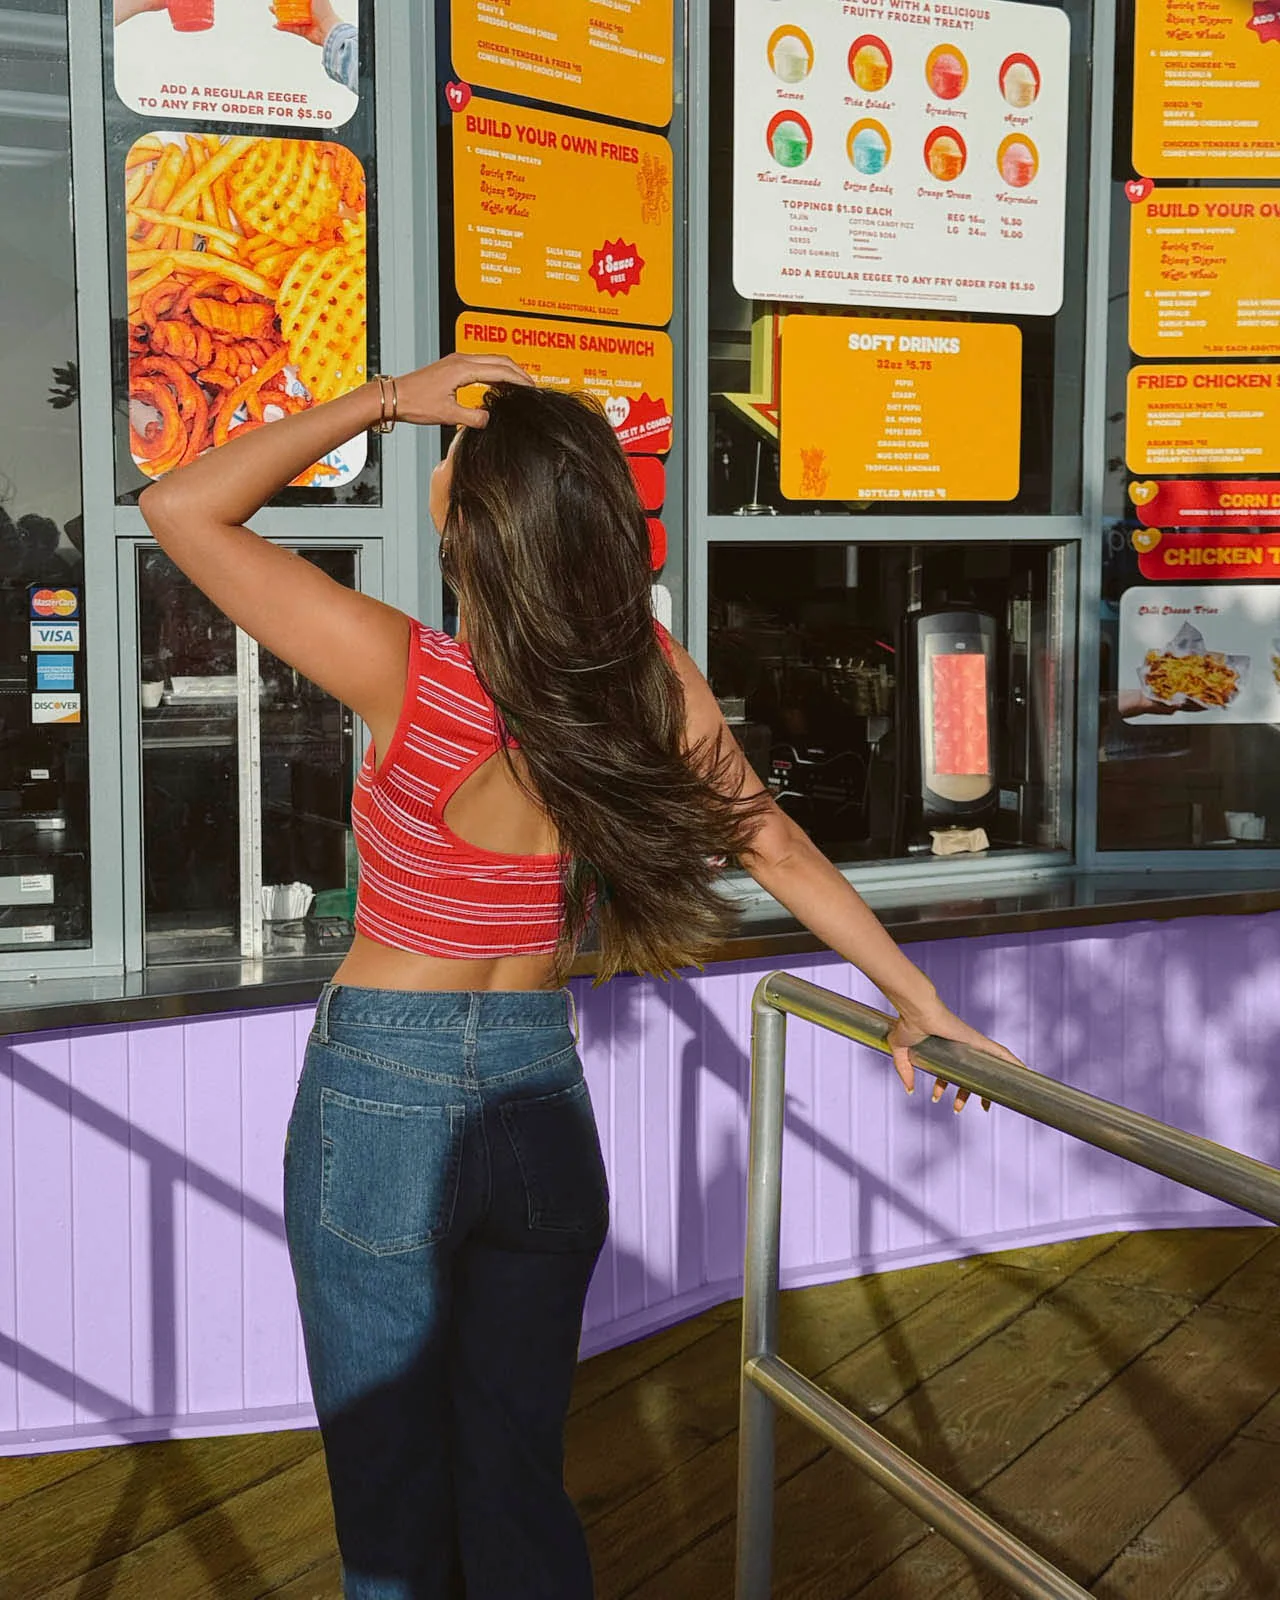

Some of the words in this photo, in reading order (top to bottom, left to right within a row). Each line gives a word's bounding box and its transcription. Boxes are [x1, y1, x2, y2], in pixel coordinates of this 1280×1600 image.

[890, 0, 920, 11] WITH
[923, 3, 931, 13] A
[934, 4, 991, 20] DELICIOUS
[842, 5, 883, 19] FRUITY
[887, 11, 931, 25] FROZEN
[934, 17, 974, 31] TREAT!
[160, 84, 187, 95] ADD
[191, 86, 200, 96] A
[204, 87, 264, 101] REGULAR
[267, 92, 308, 104] EEGEE
[450, 88, 462, 104] $7
[138, 97, 157, 107] TO
[162, 99, 188, 110] ANY
[193, 101, 218, 112] FRY
[222, 103, 264, 116] ORDER
[268, 106, 293, 118] FOR
[297, 107, 332, 120] $5.50
[466, 115, 512, 140] BUILD
[515, 125, 557, 149] YOUR
[561, 134, 597, 156] OWN
[601, 142, 639, 164] FRIES
[1130, 184, 1144, 196] $7
[782, 200, 833, 212] TOPPINGS
[836, 203, 863, 214] $1.50
[866, 207, 893, 216] EACH
[1147, 204, 1200, 218] BUILD
[1205, 204, 1255, 217] YOUR
[947, 213, 965, 222] REG
[947, 226, 959, 234] LG
[598, 260, 605, 276] 1
[604, 254, 635, 273] Sauce
[610, 273, 626, 284] FREE
[781, 267, 801, 277] ADD
[804, 269, 812, 278] A
[814, 269, 859, 281] REGULAR
[862, 272, 892, 283] EEGEE
[896, 275, 909, 284] TO
[912, 275, 932, 285] ANY
[934, 277, 953, 286] FRY
[955, 278, 986, 288] ORDER
[989, 280, 1007, 290] FOR
[1010, 281, 1035, 291] $5.50
[519, 297, 537, 306] $1.50
[538, 300, 556, 308] EACH
[557, 301, 597, 313] ADDITIONAL
[598, 307, 620, 315] SAUCE
[464, 323, 507, 343] FRIED
[511, 328, 576, 350] CHICKEN
[579, 335, 655, 357] SANDWICH
[848, 333, 896, 352] SOFT
[898, 335, 960, 354] DRINKS
[877, 360, 903, 369] 32oz
[906, 360, 932, 371] $5.75
[895, 379, 914, 387] PEPSI
[1137, 375, 1188, 389] FRIED
[1193, 374, 1272, 388] CHICKEN
[616, 429, 630, 440] AKE
[630, 426, 638, 437] IT
[639, 424, 646, 434] A
[646, 416, 672, 430] COMBO
[858, 489, 900, 498] BOTTLED
[902, 489, 935, 498] WATER
[1219, 494, 1268, 507] CORN
[1163, 547, 1263, 566] CHICKEN
[33, 598, 77, 608] MasterCard
[1138, 605, 1160, 616] Chili
[1161, 605, 1192, 616] Cheese
[1193, 605, 1219, 615] Fries
[39, 630, 74, 642] VISA
[34, 701, 78, 710] DISCOVER
